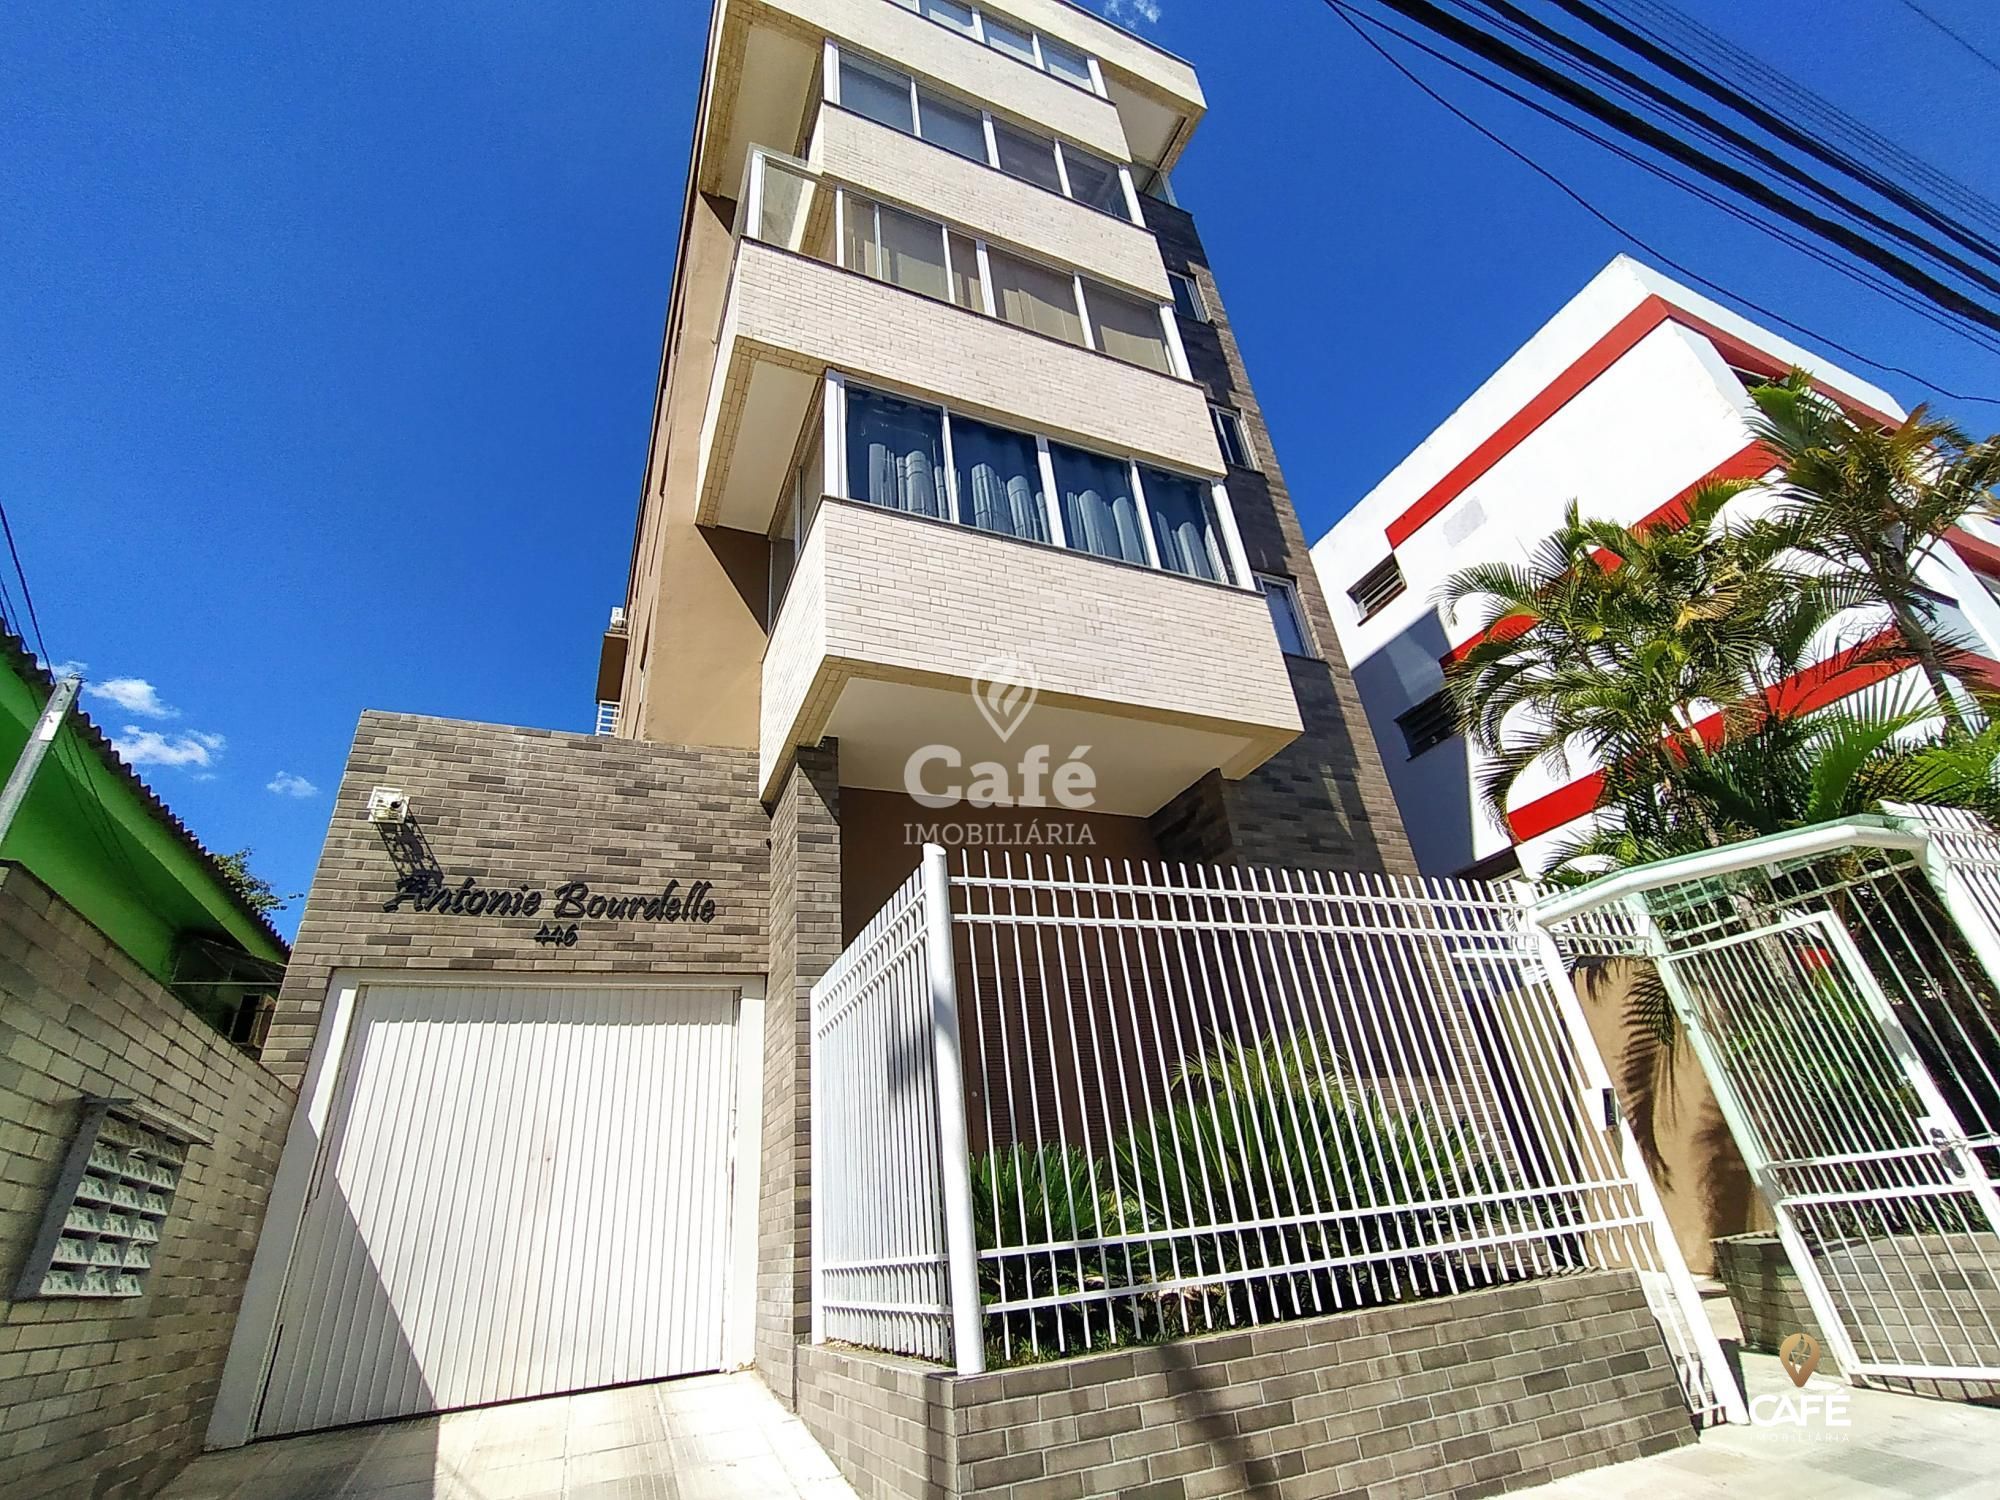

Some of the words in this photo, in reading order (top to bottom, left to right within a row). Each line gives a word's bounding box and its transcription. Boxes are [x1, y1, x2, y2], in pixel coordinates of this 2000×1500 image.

[383, 877, 541, 917] Antonie
[553, 879, 716, 923] Bourdelle
[534, 923, 579, 947] 446
